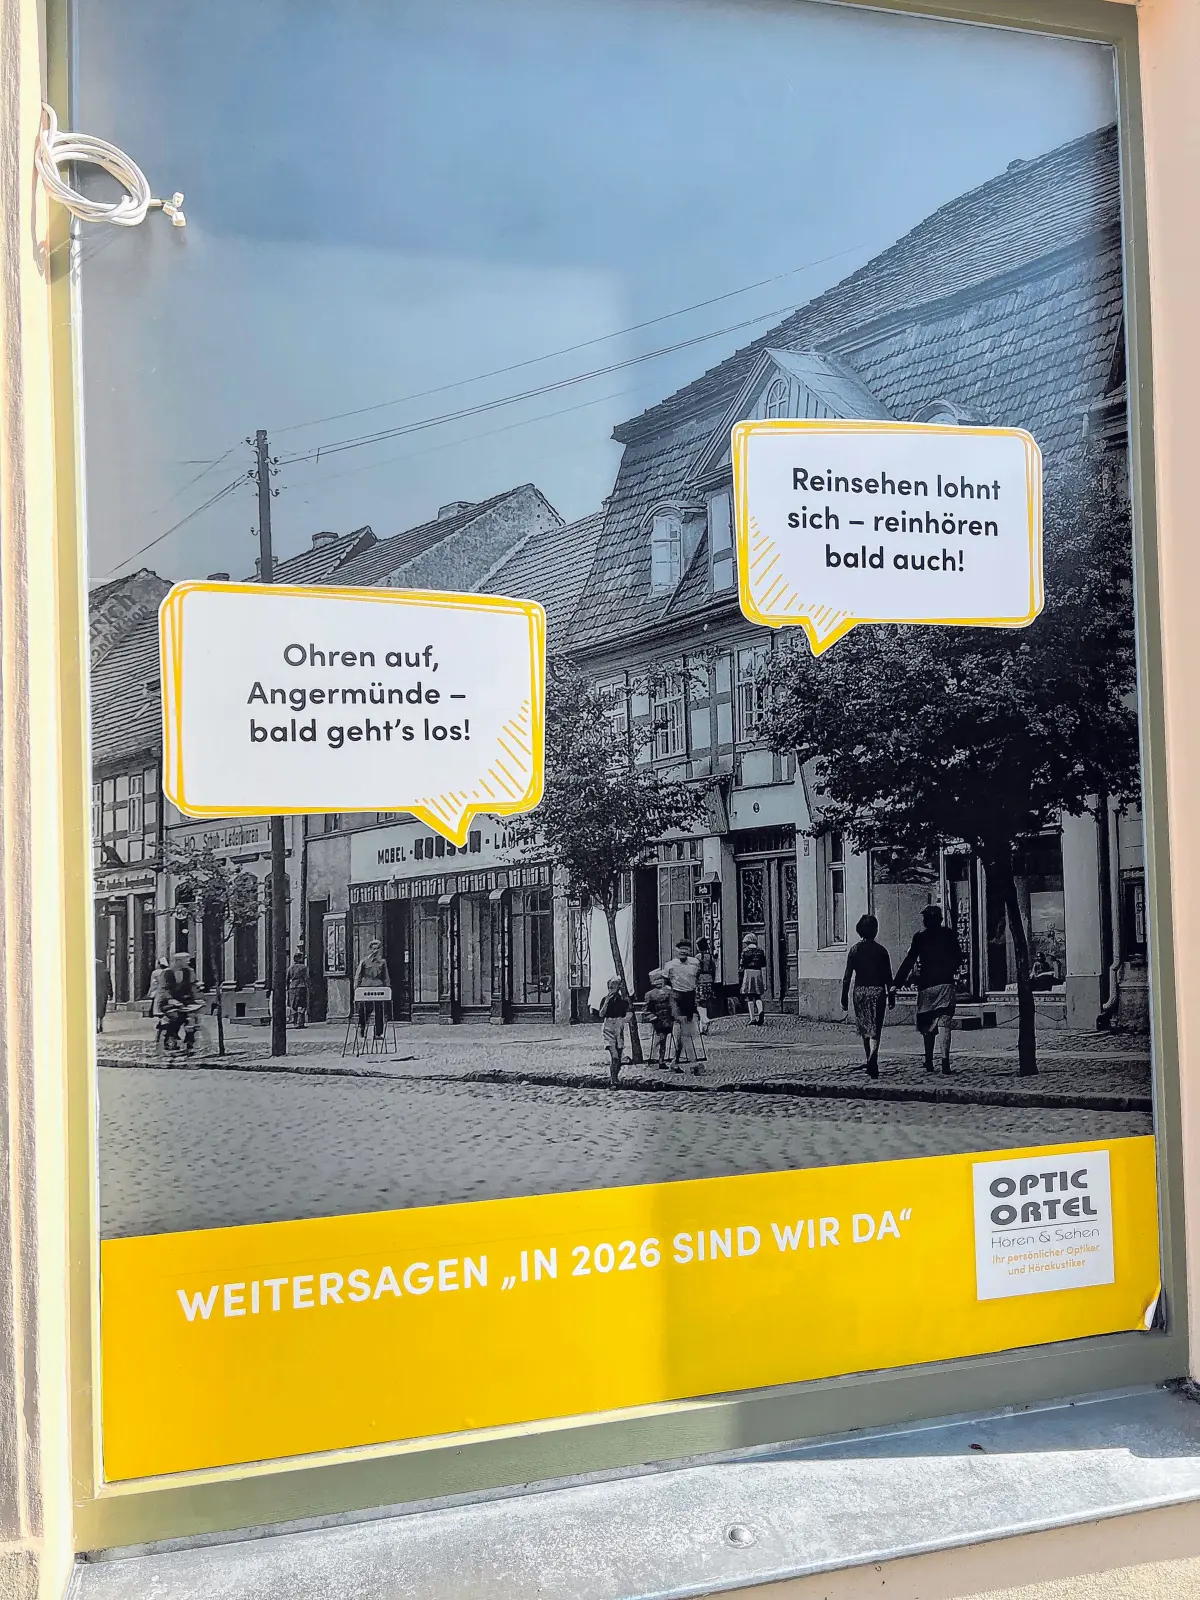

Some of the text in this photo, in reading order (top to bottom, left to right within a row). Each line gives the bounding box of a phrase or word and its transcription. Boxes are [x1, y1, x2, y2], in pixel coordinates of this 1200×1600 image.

[792, 467, 1001, 501] Reinsehen lohnt
[787, 505, 840, 530] sich
[873, 509, 999, 537] reinhören
[825, 543, 964, 573] bald auch!
[283, 643, 439, 673] Ohren auf,
[246, 681, 441, 712] Angermünde
[250, 718, 317, 743] bald
[424, 718, 470, 741] los!
[989, 1168, 1088, 1198] OPTIC
[990, 1195, 1098, 1226] ORTEL
[991, 1228, 1100, 1249] Hören & Sehen
[177, 1255, 488, 1322] WEITERSAGEN
[571, 1237, 661, 1277] 2026
[673, 1225, 761, 1264] SIND
[771, 1216, 840, 1252] WIR
[992, 1243, 1100, 1265] Ihr persönlicher Optiker
[1008, 1258, 1086, 1276] und Hörakustiker
